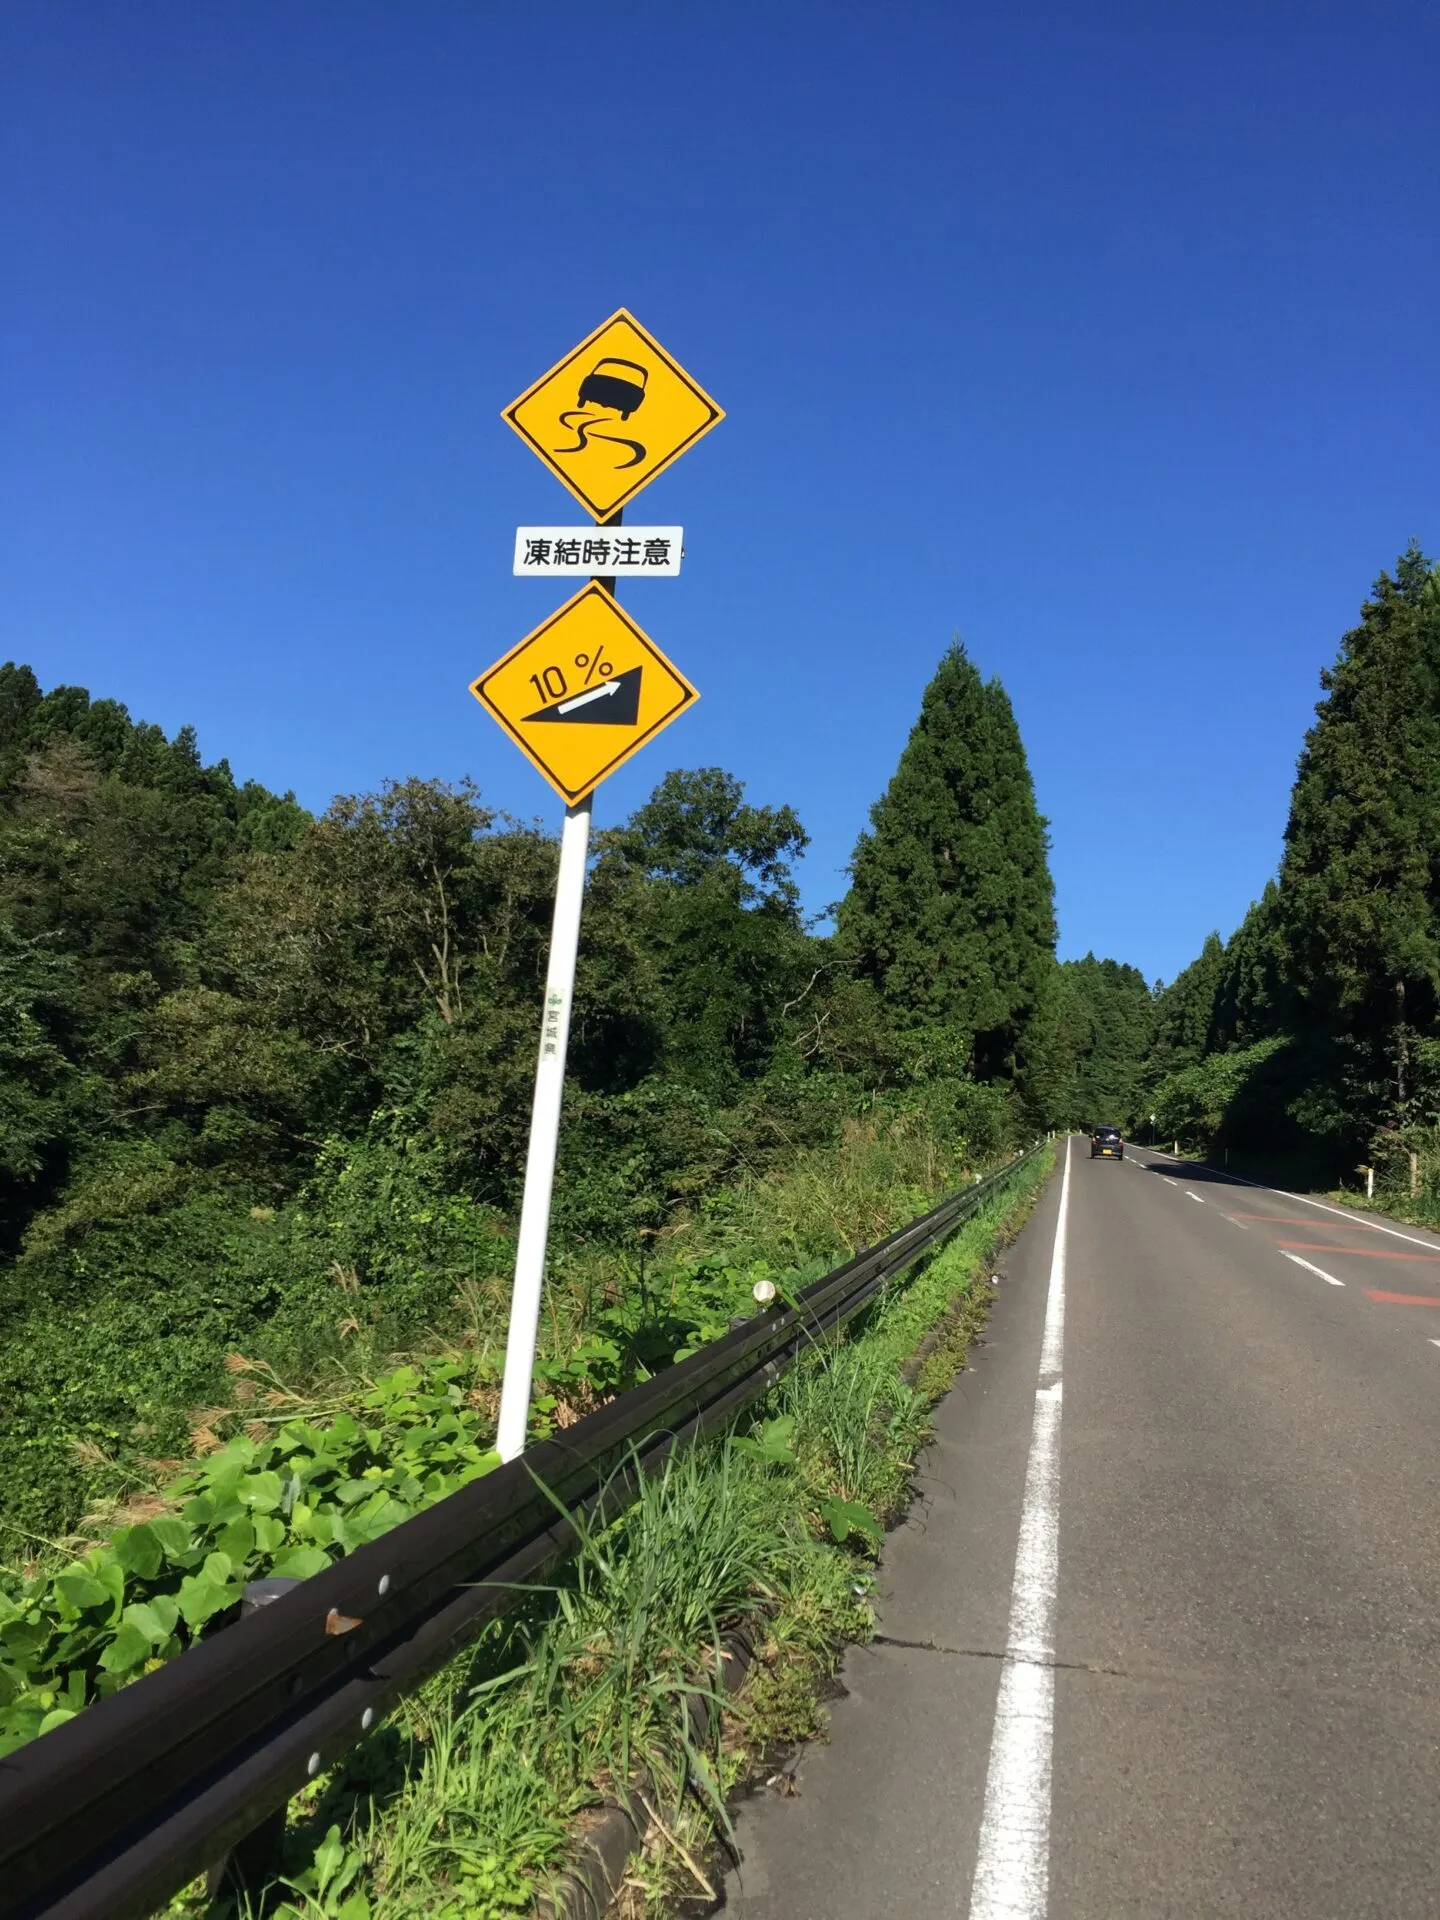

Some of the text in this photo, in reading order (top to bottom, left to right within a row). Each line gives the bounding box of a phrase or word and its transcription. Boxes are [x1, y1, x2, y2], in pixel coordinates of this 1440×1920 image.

[523, 538, 671, 565] 凍結時注意
